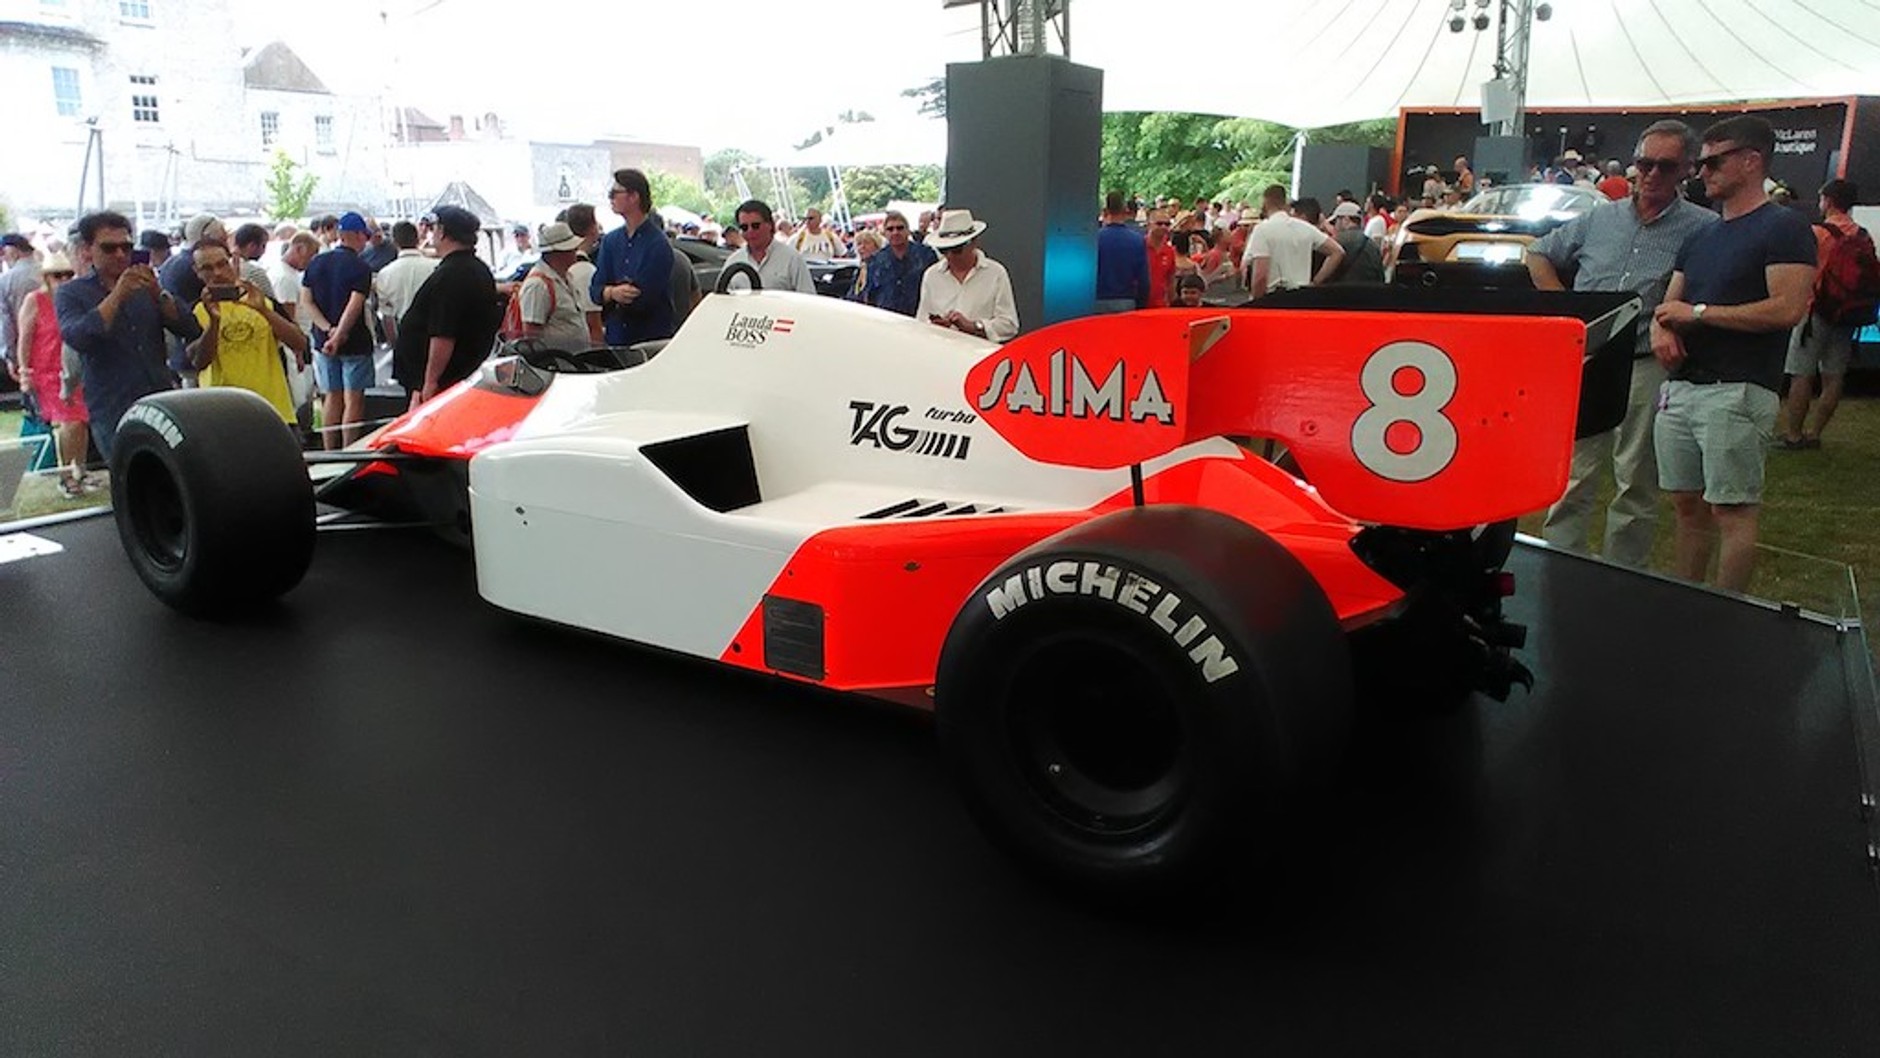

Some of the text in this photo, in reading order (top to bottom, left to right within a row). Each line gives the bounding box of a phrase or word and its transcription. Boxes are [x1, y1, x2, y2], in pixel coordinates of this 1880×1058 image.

[725, 327, 768, 344] BOSS
[731, 313, 774, 331] Lauda
[978, 347, 1175, 425] SAIMA
[1350, 339, 1459, 484] 8
[849, 400, 977, 451] TAG turbo
[986, 558, 1239, 683] MICHELIN
